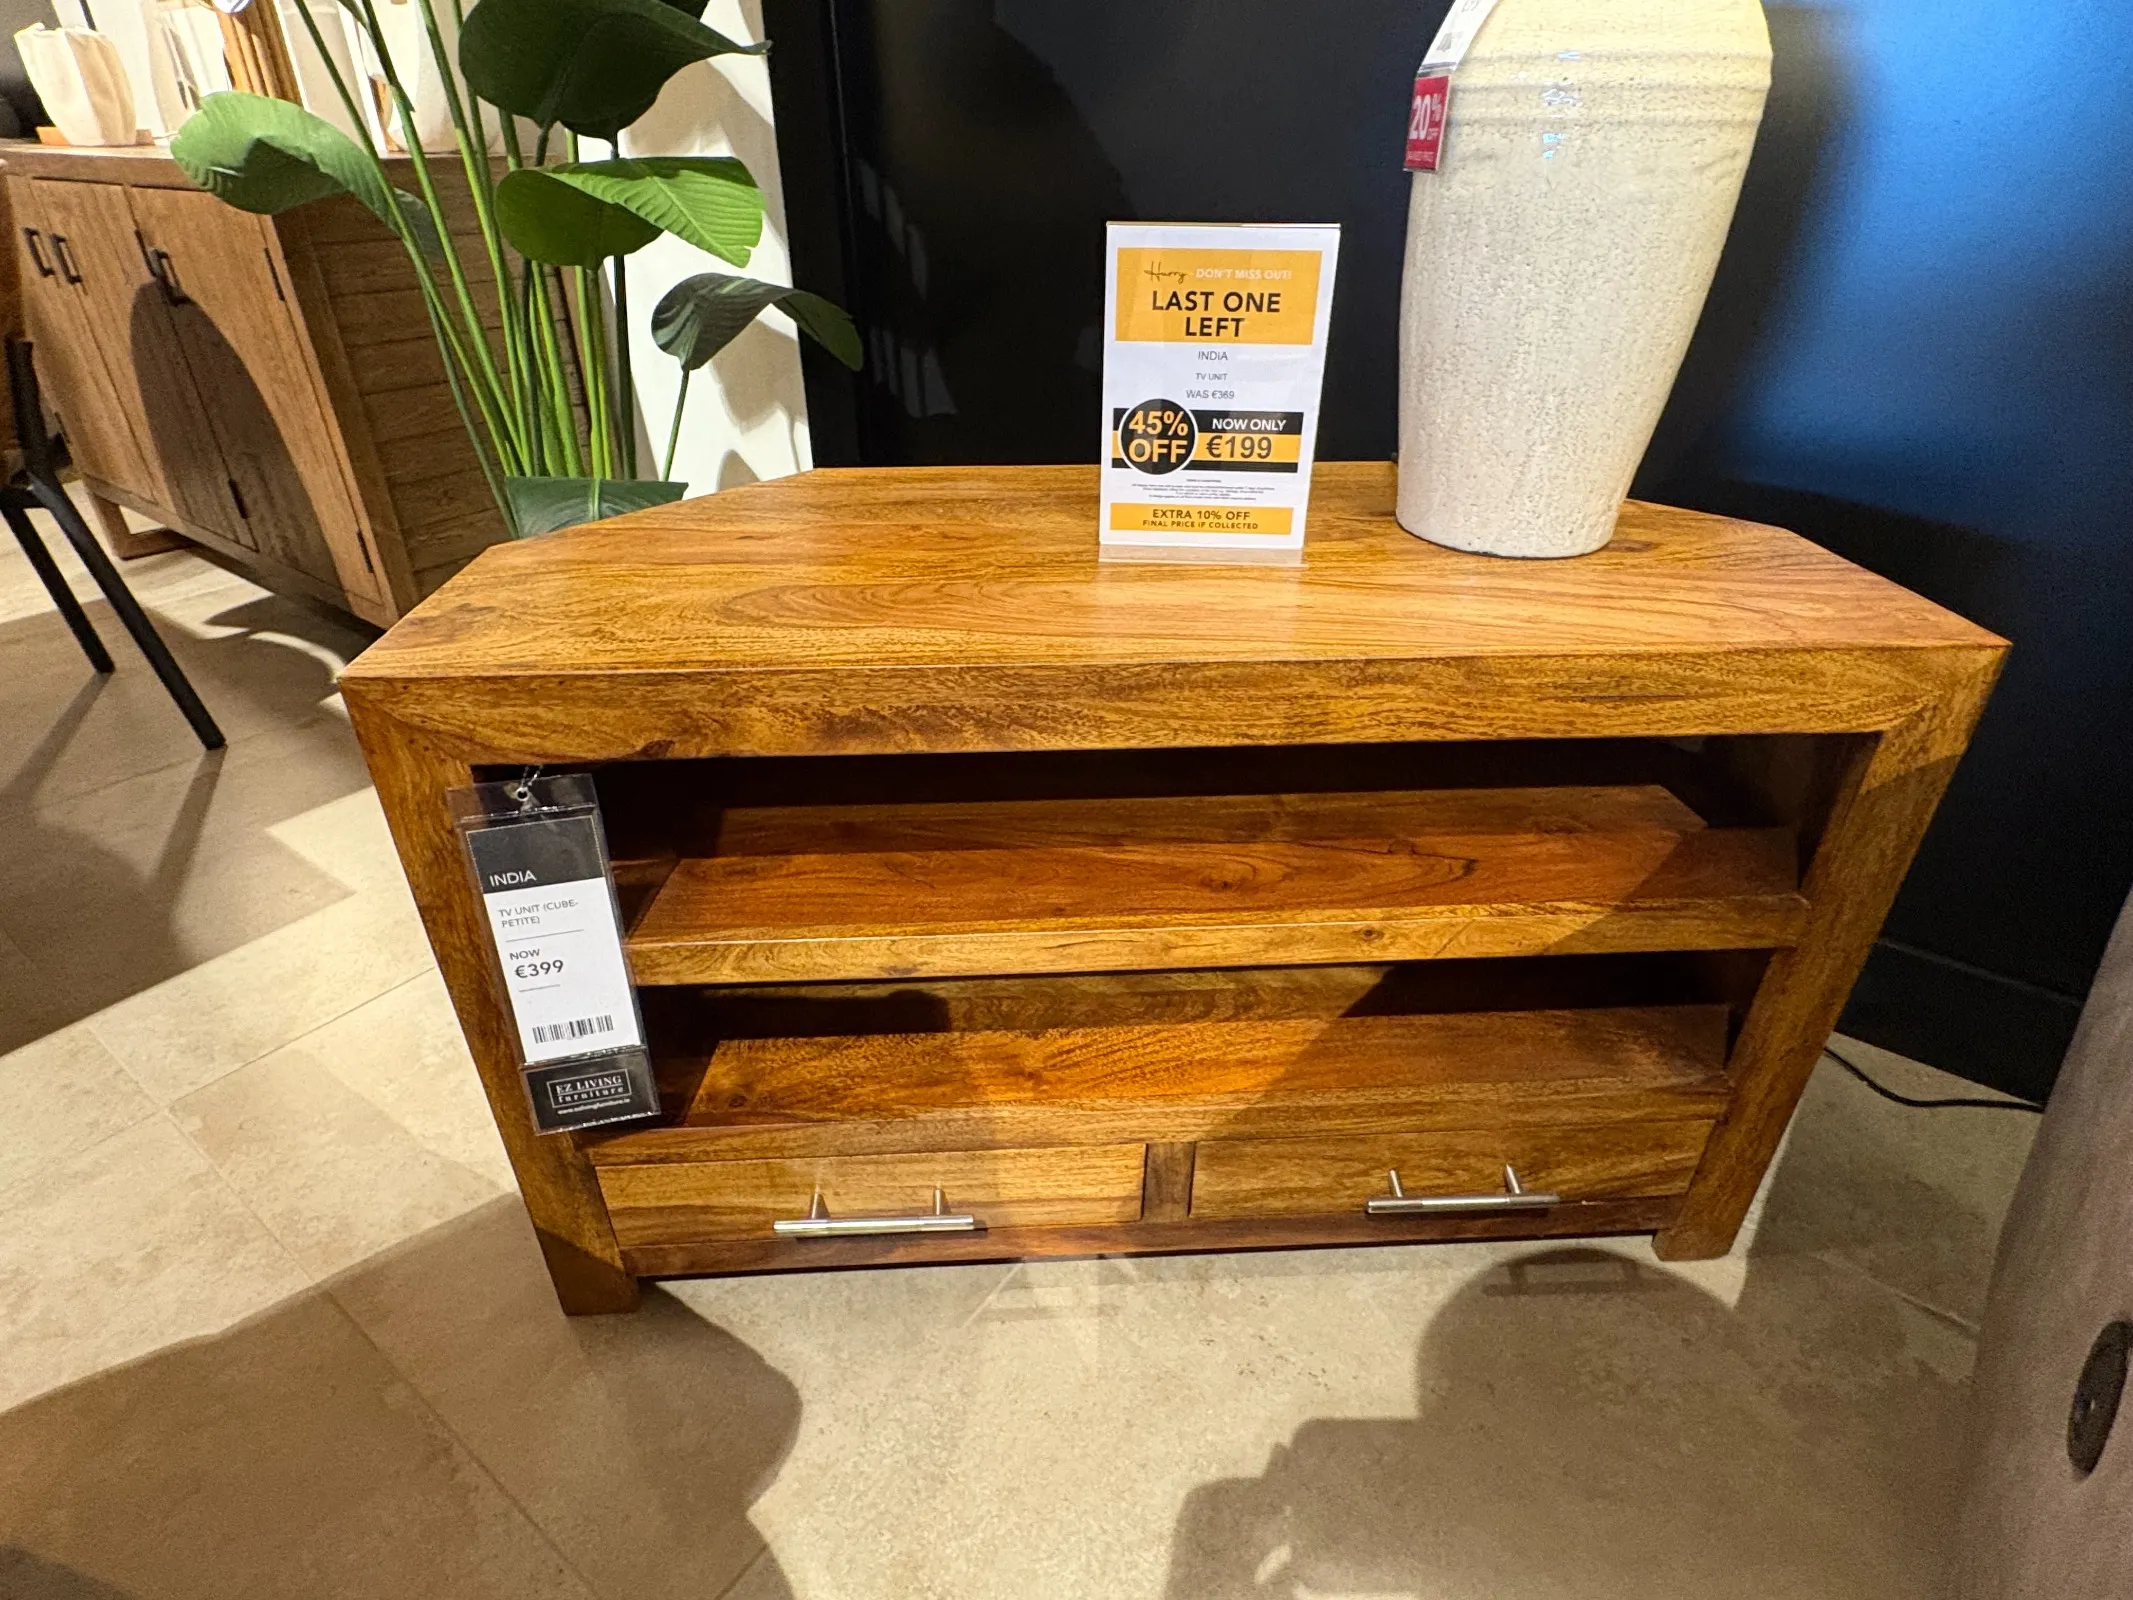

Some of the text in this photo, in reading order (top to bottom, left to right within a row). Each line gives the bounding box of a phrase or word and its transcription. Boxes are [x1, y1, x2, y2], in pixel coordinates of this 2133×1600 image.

[1144, 261, 1292, 284] Hurry DON'T MISS OUT!
[1152, 290, 1281, 312] LAST ONE
[1185, 317, 1245, 337] LEFT
[1197, 351, 1228, 361] INDIA
[1196, 373, 1228, 381] TV UNIT
[1186, 390, 1235, 400] WAS €369
[1128, 410, 1189, 437] 45%
[1212, 418, 1287, 431] NOW ONLY
[1129, 439, 1188, 463] OFF
[1206, 435, 1272, 459] €199
[1152, 509, 1250, 521] EXTRA 10% OFF
[1208, 522, 1258, 530] COLLECTED
[489, 870, 537, 887] INDIA
[498, 908, 512, 917] TV
[514, 904, 541, 915] UNIT
[501, 916, 540, 928] PETITE)
[509, 949, 541, 961] NOW
[515, 959, 564, 979] €399
[556, 1075, 622, 1094] EZ LIVING
[558, 1087, 624, 1103] furniture
